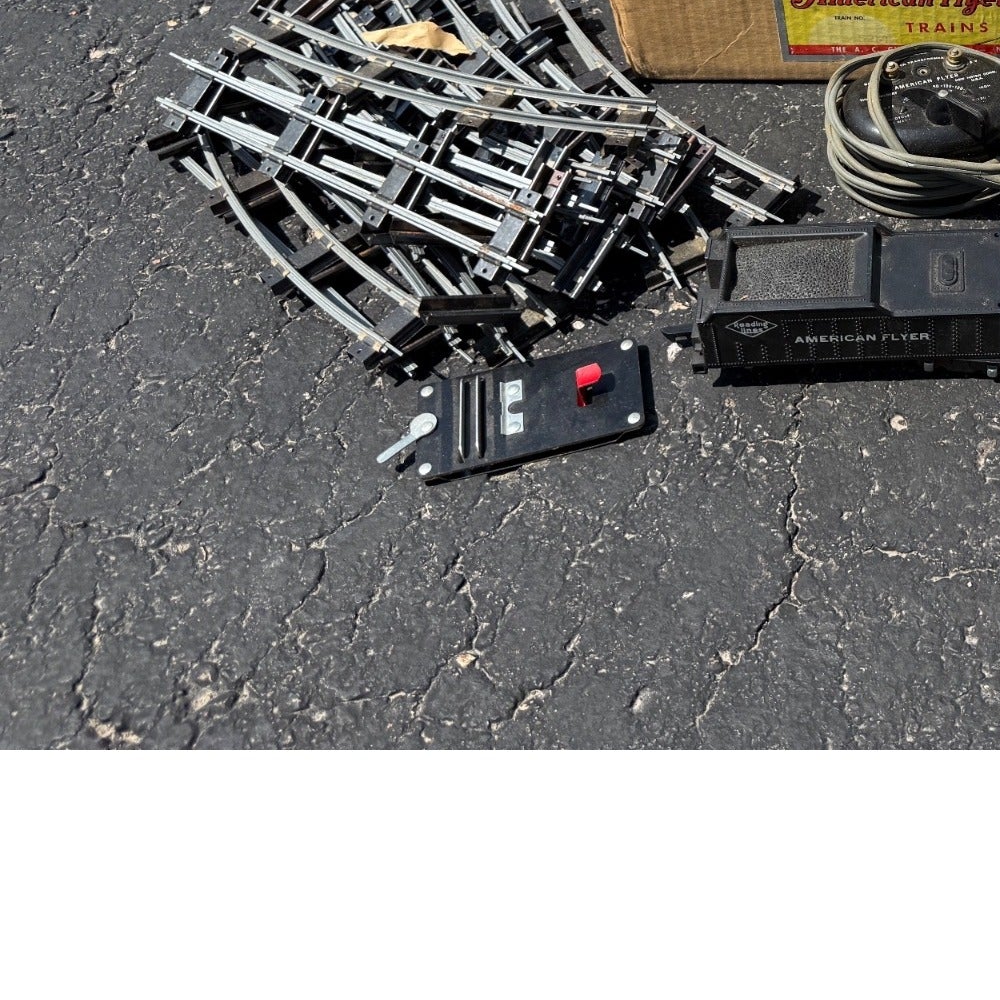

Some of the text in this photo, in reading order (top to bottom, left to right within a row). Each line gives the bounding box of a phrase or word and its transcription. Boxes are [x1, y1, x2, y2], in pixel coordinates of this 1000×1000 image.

[906, 22, 989, 33] TRAINS
[894, 79, 933, 91] AMERICAN
[936, 73, 959, 82] FLYER
[733, 320, 769, 329] Reading
[794, 332, 931, 344] AMERICAN FLYER
